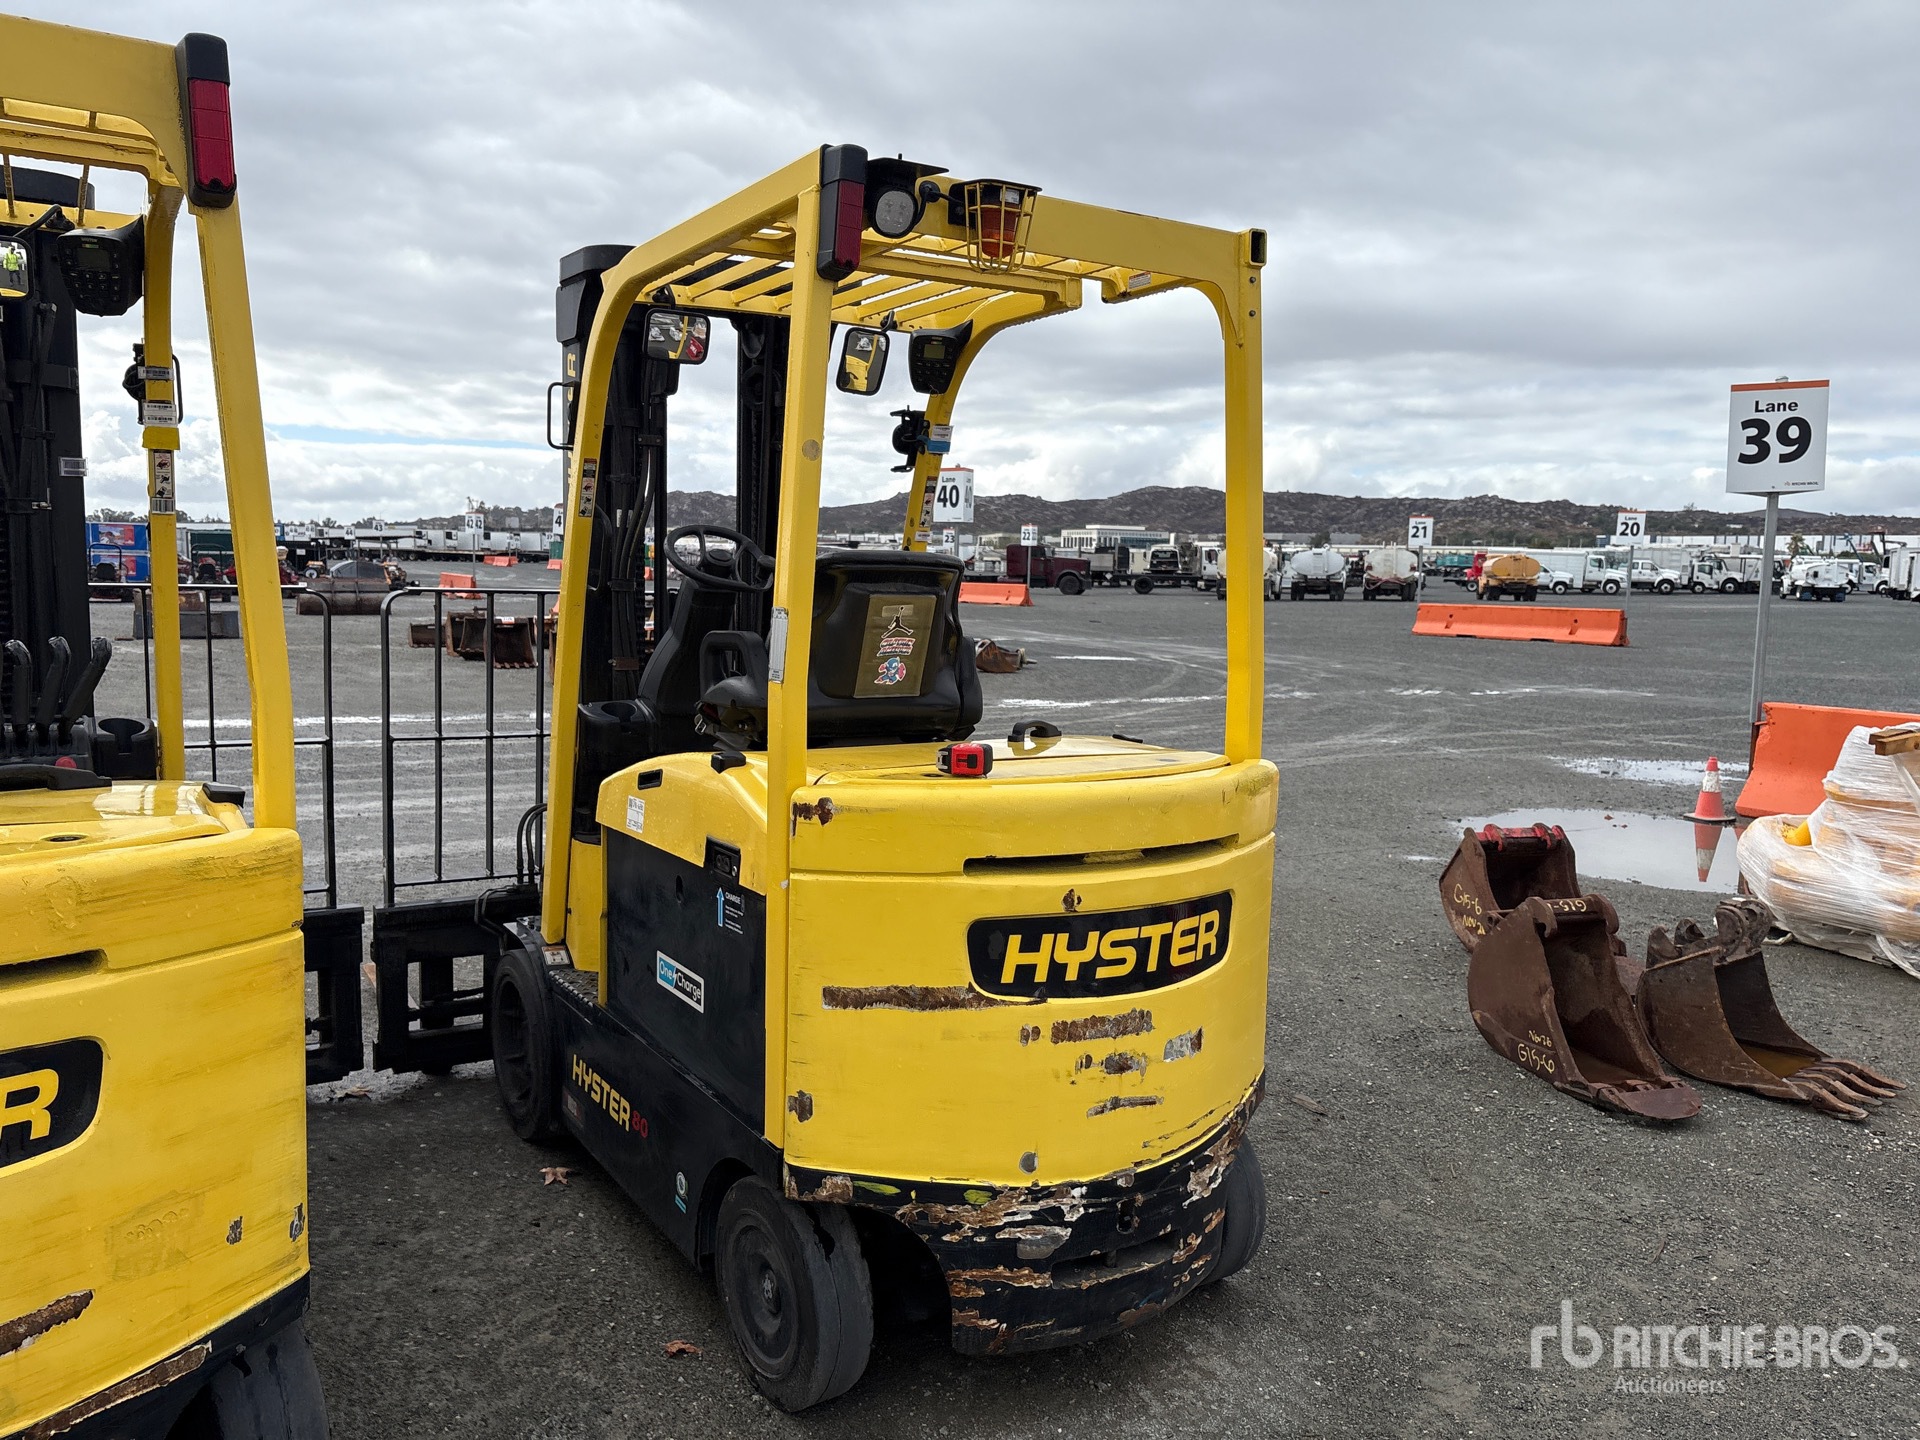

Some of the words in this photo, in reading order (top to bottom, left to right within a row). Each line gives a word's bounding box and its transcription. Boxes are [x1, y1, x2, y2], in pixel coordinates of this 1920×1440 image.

[1754, 400, 1799, 413] Lane
[1738, 416, 1812, 464] 39
[937, 485, 960, 508] 40
[466, 519, 474, 529] 42
[475, 519, 483, 530] 42
[555, 515, 563, 527] 4
[345, 528, 353, 536] 44
[374, 524, 383, 532] 43
[1411, 525, 1427, 538] 21
[1619, 521, 1641, 537] 20
[944, 534, 955, 543] 23
[1022, 531, 1031, 541] 22
[725, 891, 741, 905] CHARGE
[1000, 909, 1219, 984] HYSTER
[572, 1053, 631, 1132] HYSTER
[631, 1110, 649, 1138] 80
